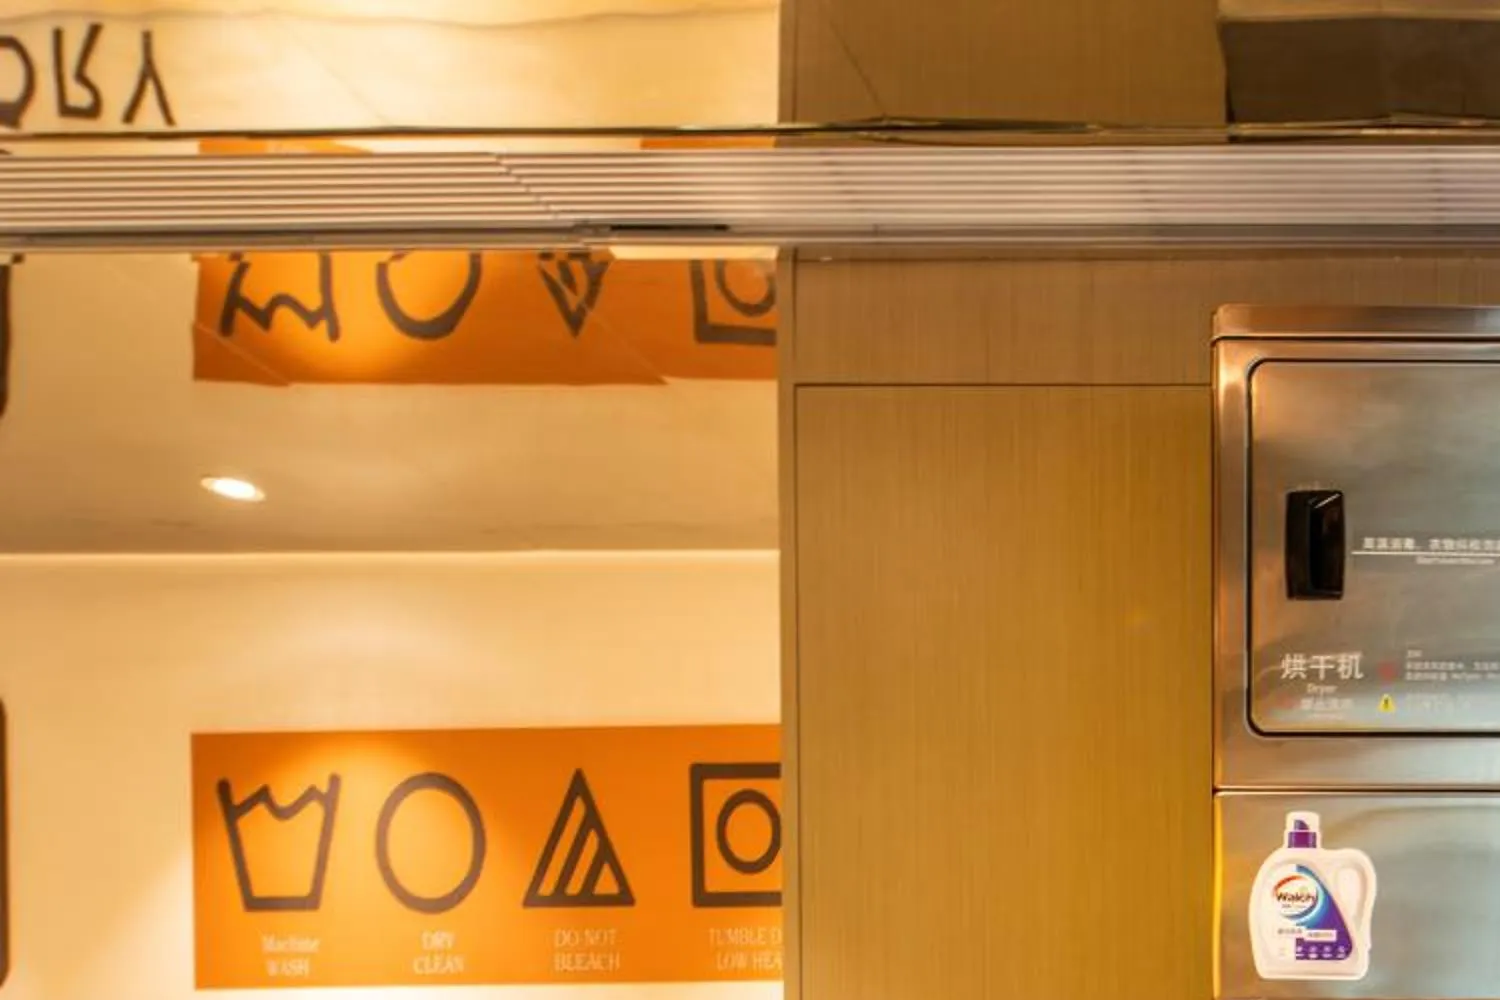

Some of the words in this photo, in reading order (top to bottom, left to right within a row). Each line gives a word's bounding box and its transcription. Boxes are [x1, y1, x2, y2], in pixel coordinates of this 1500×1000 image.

[1281, 653, 1363, 680] 烘干机
[421, 930, 456, 949] DRY
[555, 928, 580, 947] DO
[585, 928, 617, 946] NOT
[412, 955, 466, 975] CLEAN
[554, 951, 621, 972] BLEACH
[717, 952, 748, 970] LOW
